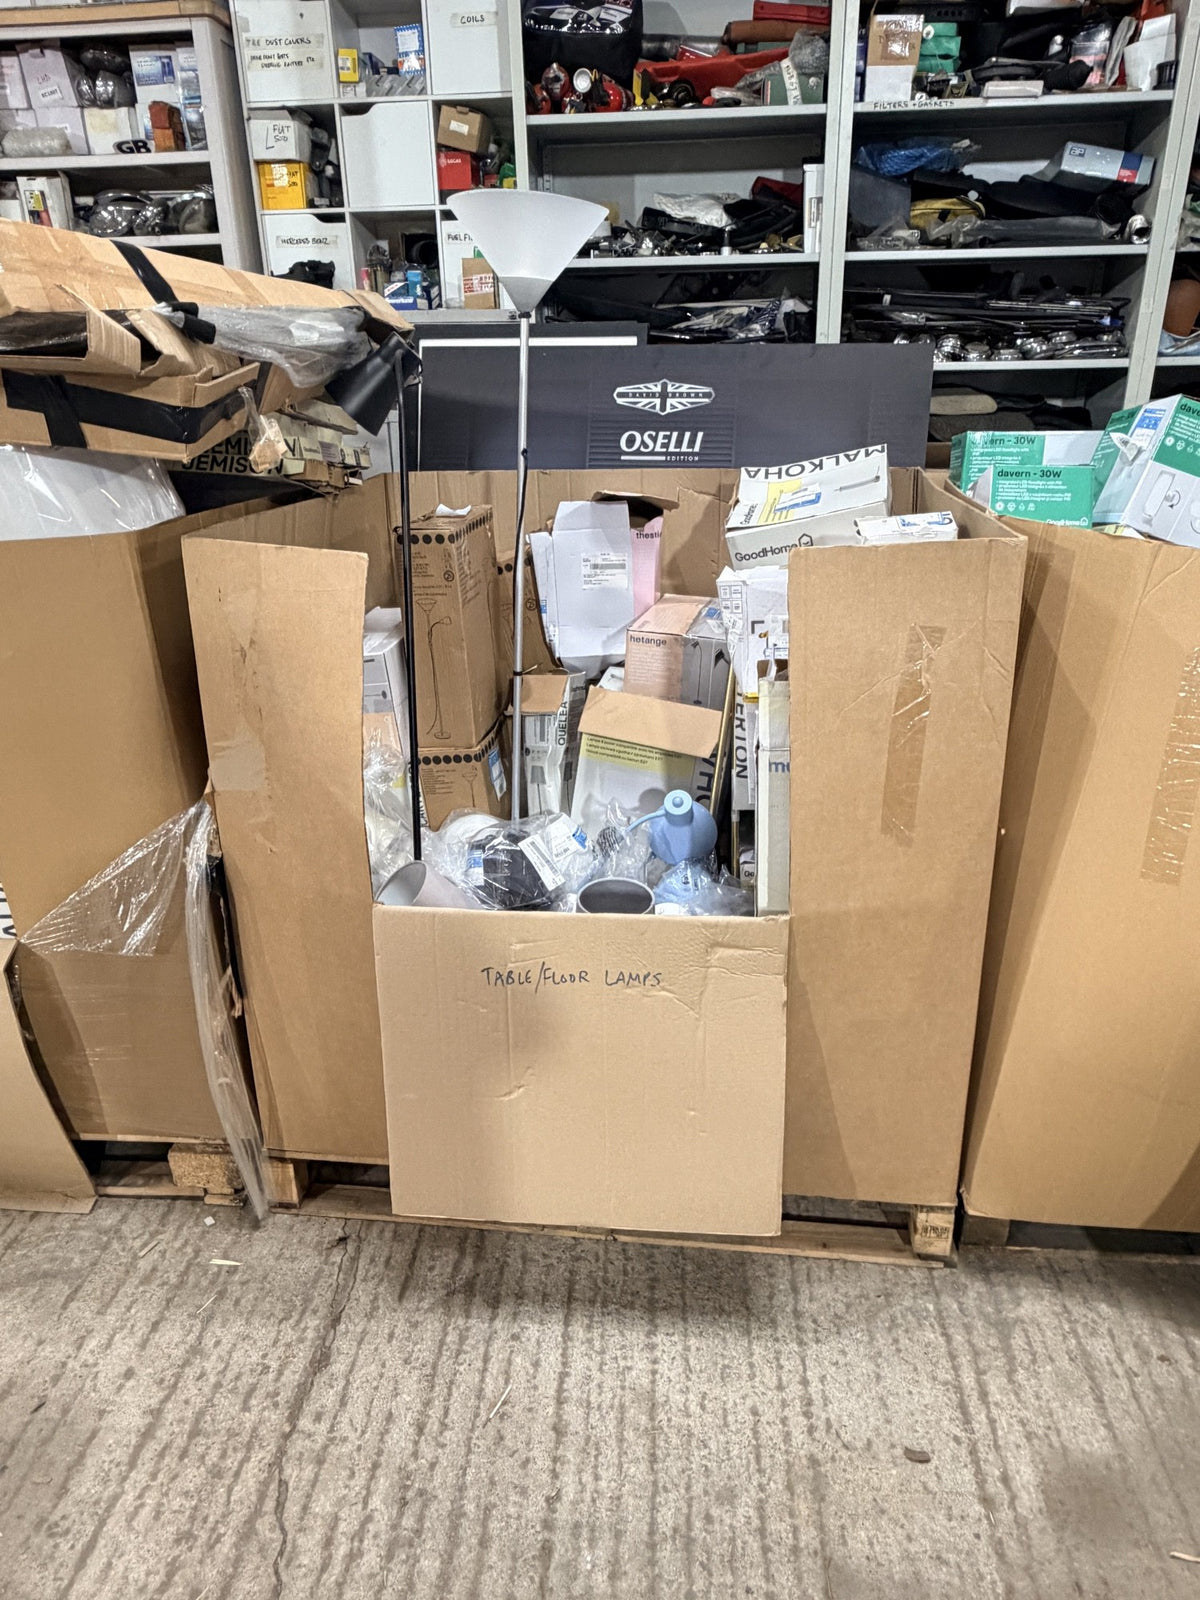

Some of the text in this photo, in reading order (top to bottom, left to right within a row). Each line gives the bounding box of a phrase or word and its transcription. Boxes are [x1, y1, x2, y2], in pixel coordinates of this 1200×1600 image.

[460, 14, 485, 25] COILS
[873, 100, 909, 110] FILTERS
[918, 100, 955, 108] GASKETS
[116, 140, 152, 154] GB
[447, 233, 463, 242] FUEL
[619, 430, 704, 453] OSELLI
[1013, 435, 1036, 445] 30W
[744, 444, 886, 480] MALKOHA
[997, 468, 1031, 478] davern
[1039, 469, 1062, 478] 30W
[629, 634, 667, 648] hetange
[557, 700, 568, 746] QUELEA
[735, 687, 749, 779] ERION
[481, 960, 662, 994] TABLE/FLOOR LAMPS
